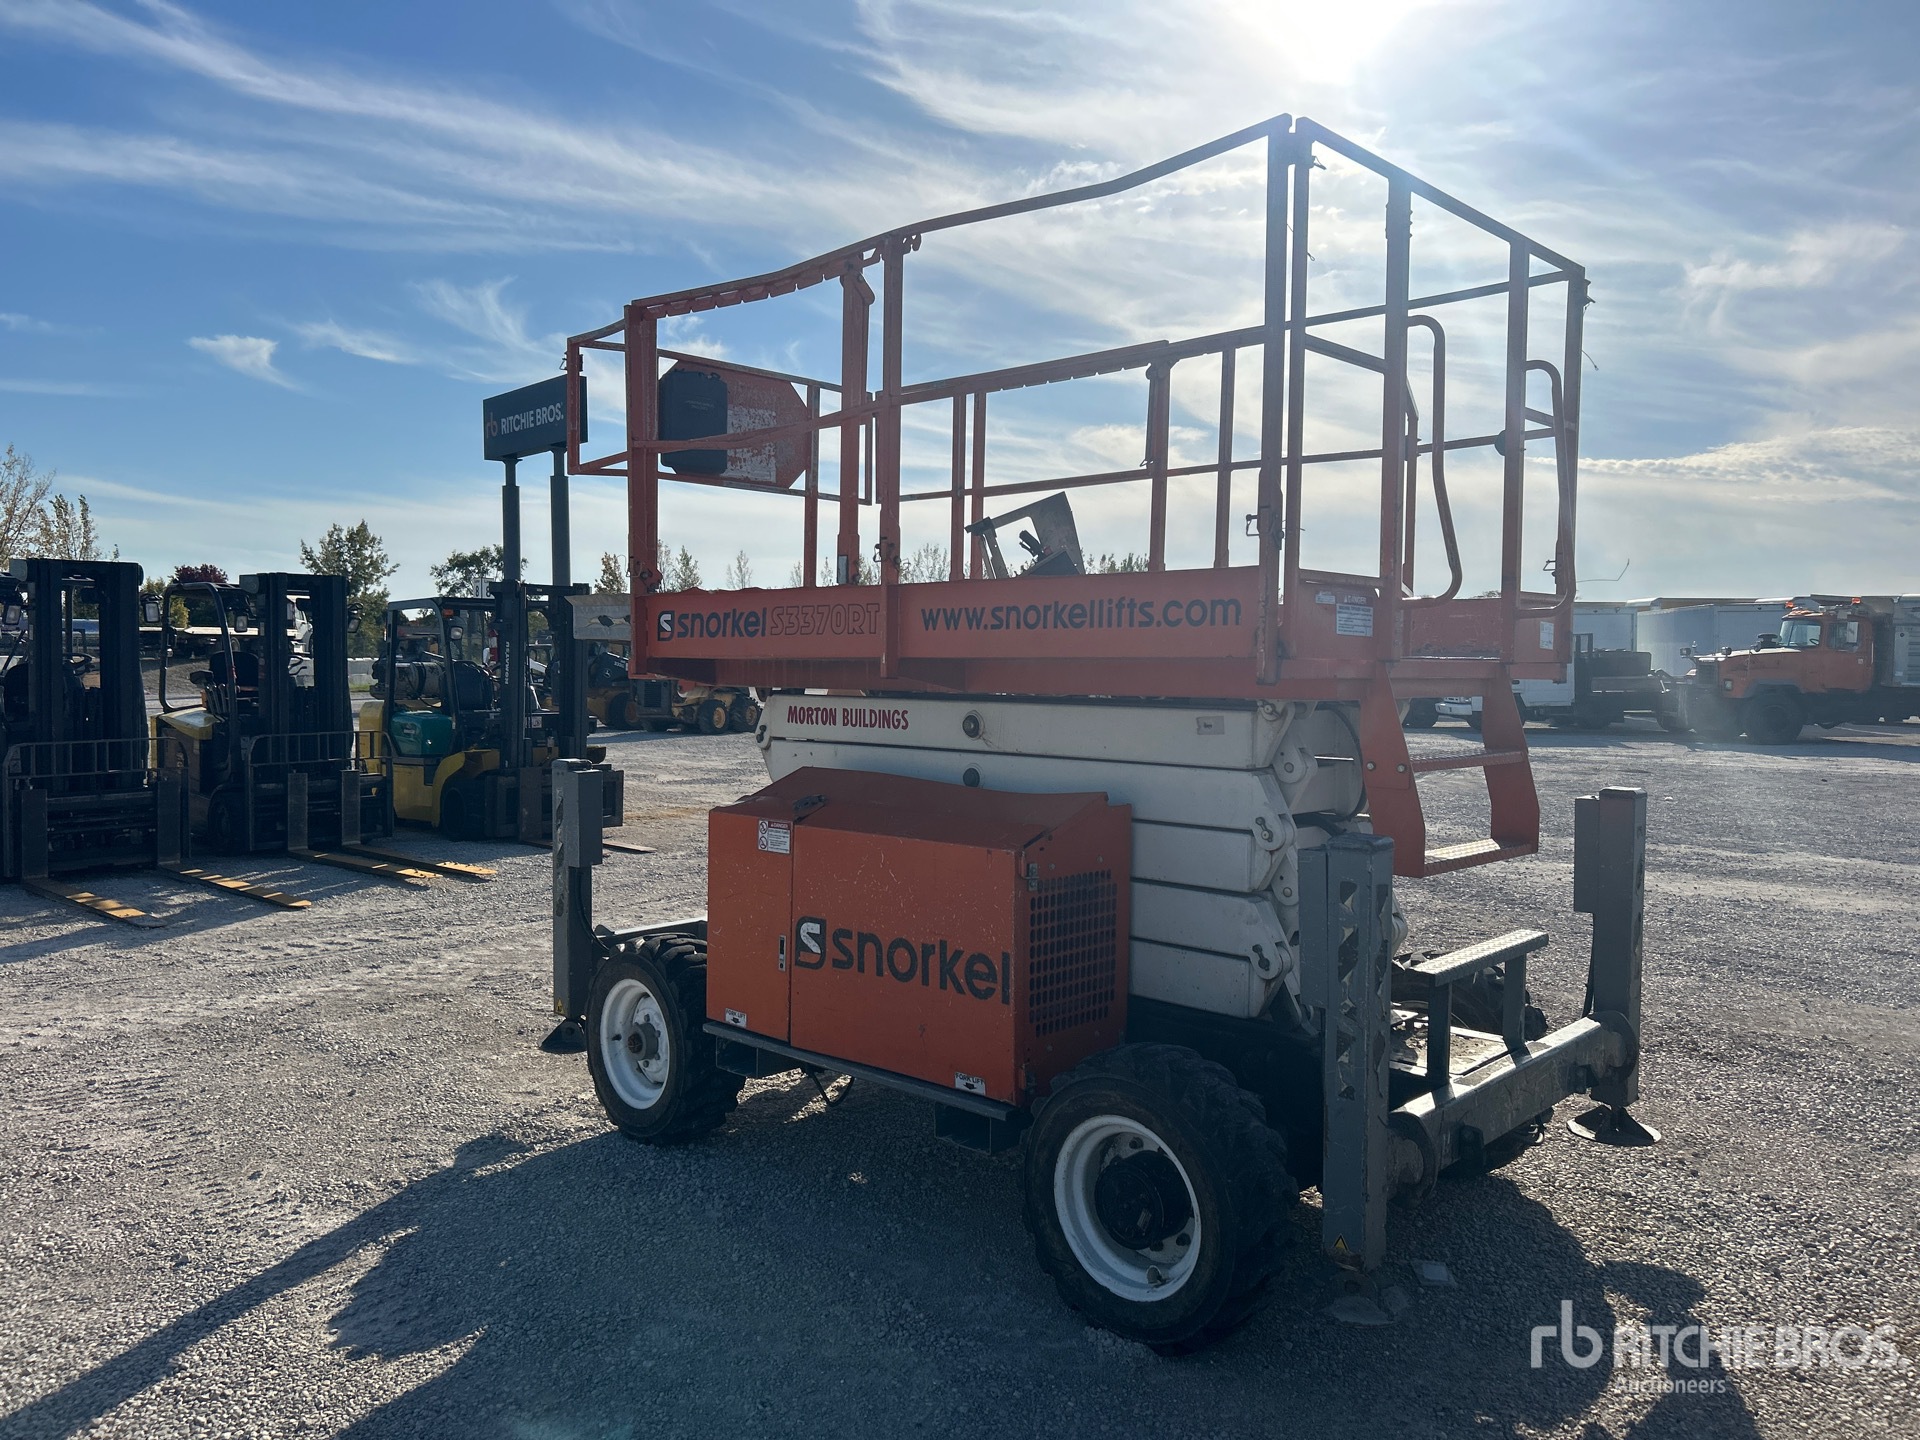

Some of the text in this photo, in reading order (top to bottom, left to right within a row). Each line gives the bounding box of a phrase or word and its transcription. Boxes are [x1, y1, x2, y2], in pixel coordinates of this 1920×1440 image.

[501, 410, 534, 435] RITCHIE
[677, 607, 767, 639] snorkel
[770, 603, 881, 636] S3370RT
[920, 597, 1242, 632] www.snorkellifts.com
[787, 705, 909, 730] MORTON BUILDINGS
[832, 928, 1011, 1005] snorkel
[955, 1072, 984, 1086] FORK LIFT
